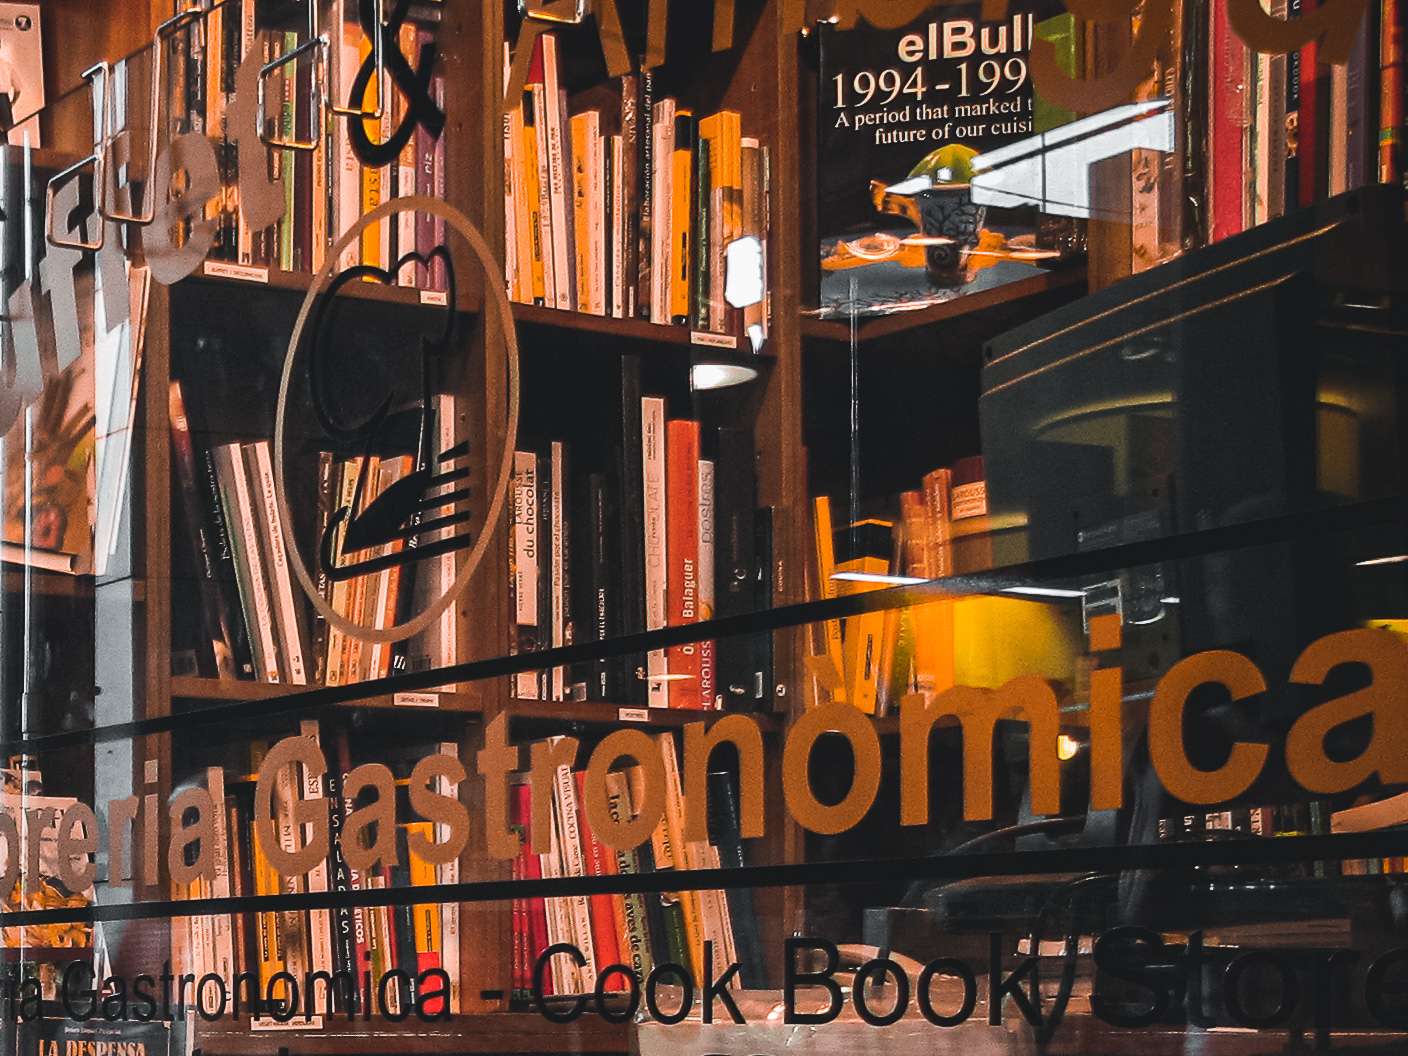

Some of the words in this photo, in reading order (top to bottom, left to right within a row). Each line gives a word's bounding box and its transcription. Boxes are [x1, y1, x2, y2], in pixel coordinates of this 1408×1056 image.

[640, 94, 651, 111] del
[832, 57, 1027, 109] 1994-199
[835, 111, 850, 129] A
[854, 105, 910, 131] period
[916, 101, 949, 121] that
[955, 97, 1022, 118] marked
[874, 128, 926, 145] future
[932, 122, 953, 140] of
[955, 123, 987, 139] our
[522, 468, 535, 535] chocolat
[523, 537, 536, 559] du
[681, 558, 696, 618] Balaguer
[254, 612, 1408, 877] Gastronomica
[63, 954, 454, 1024] Gastronomica
[532, 940, 746, 1027] Cook
[782, 936, 1043, 1029] Book
